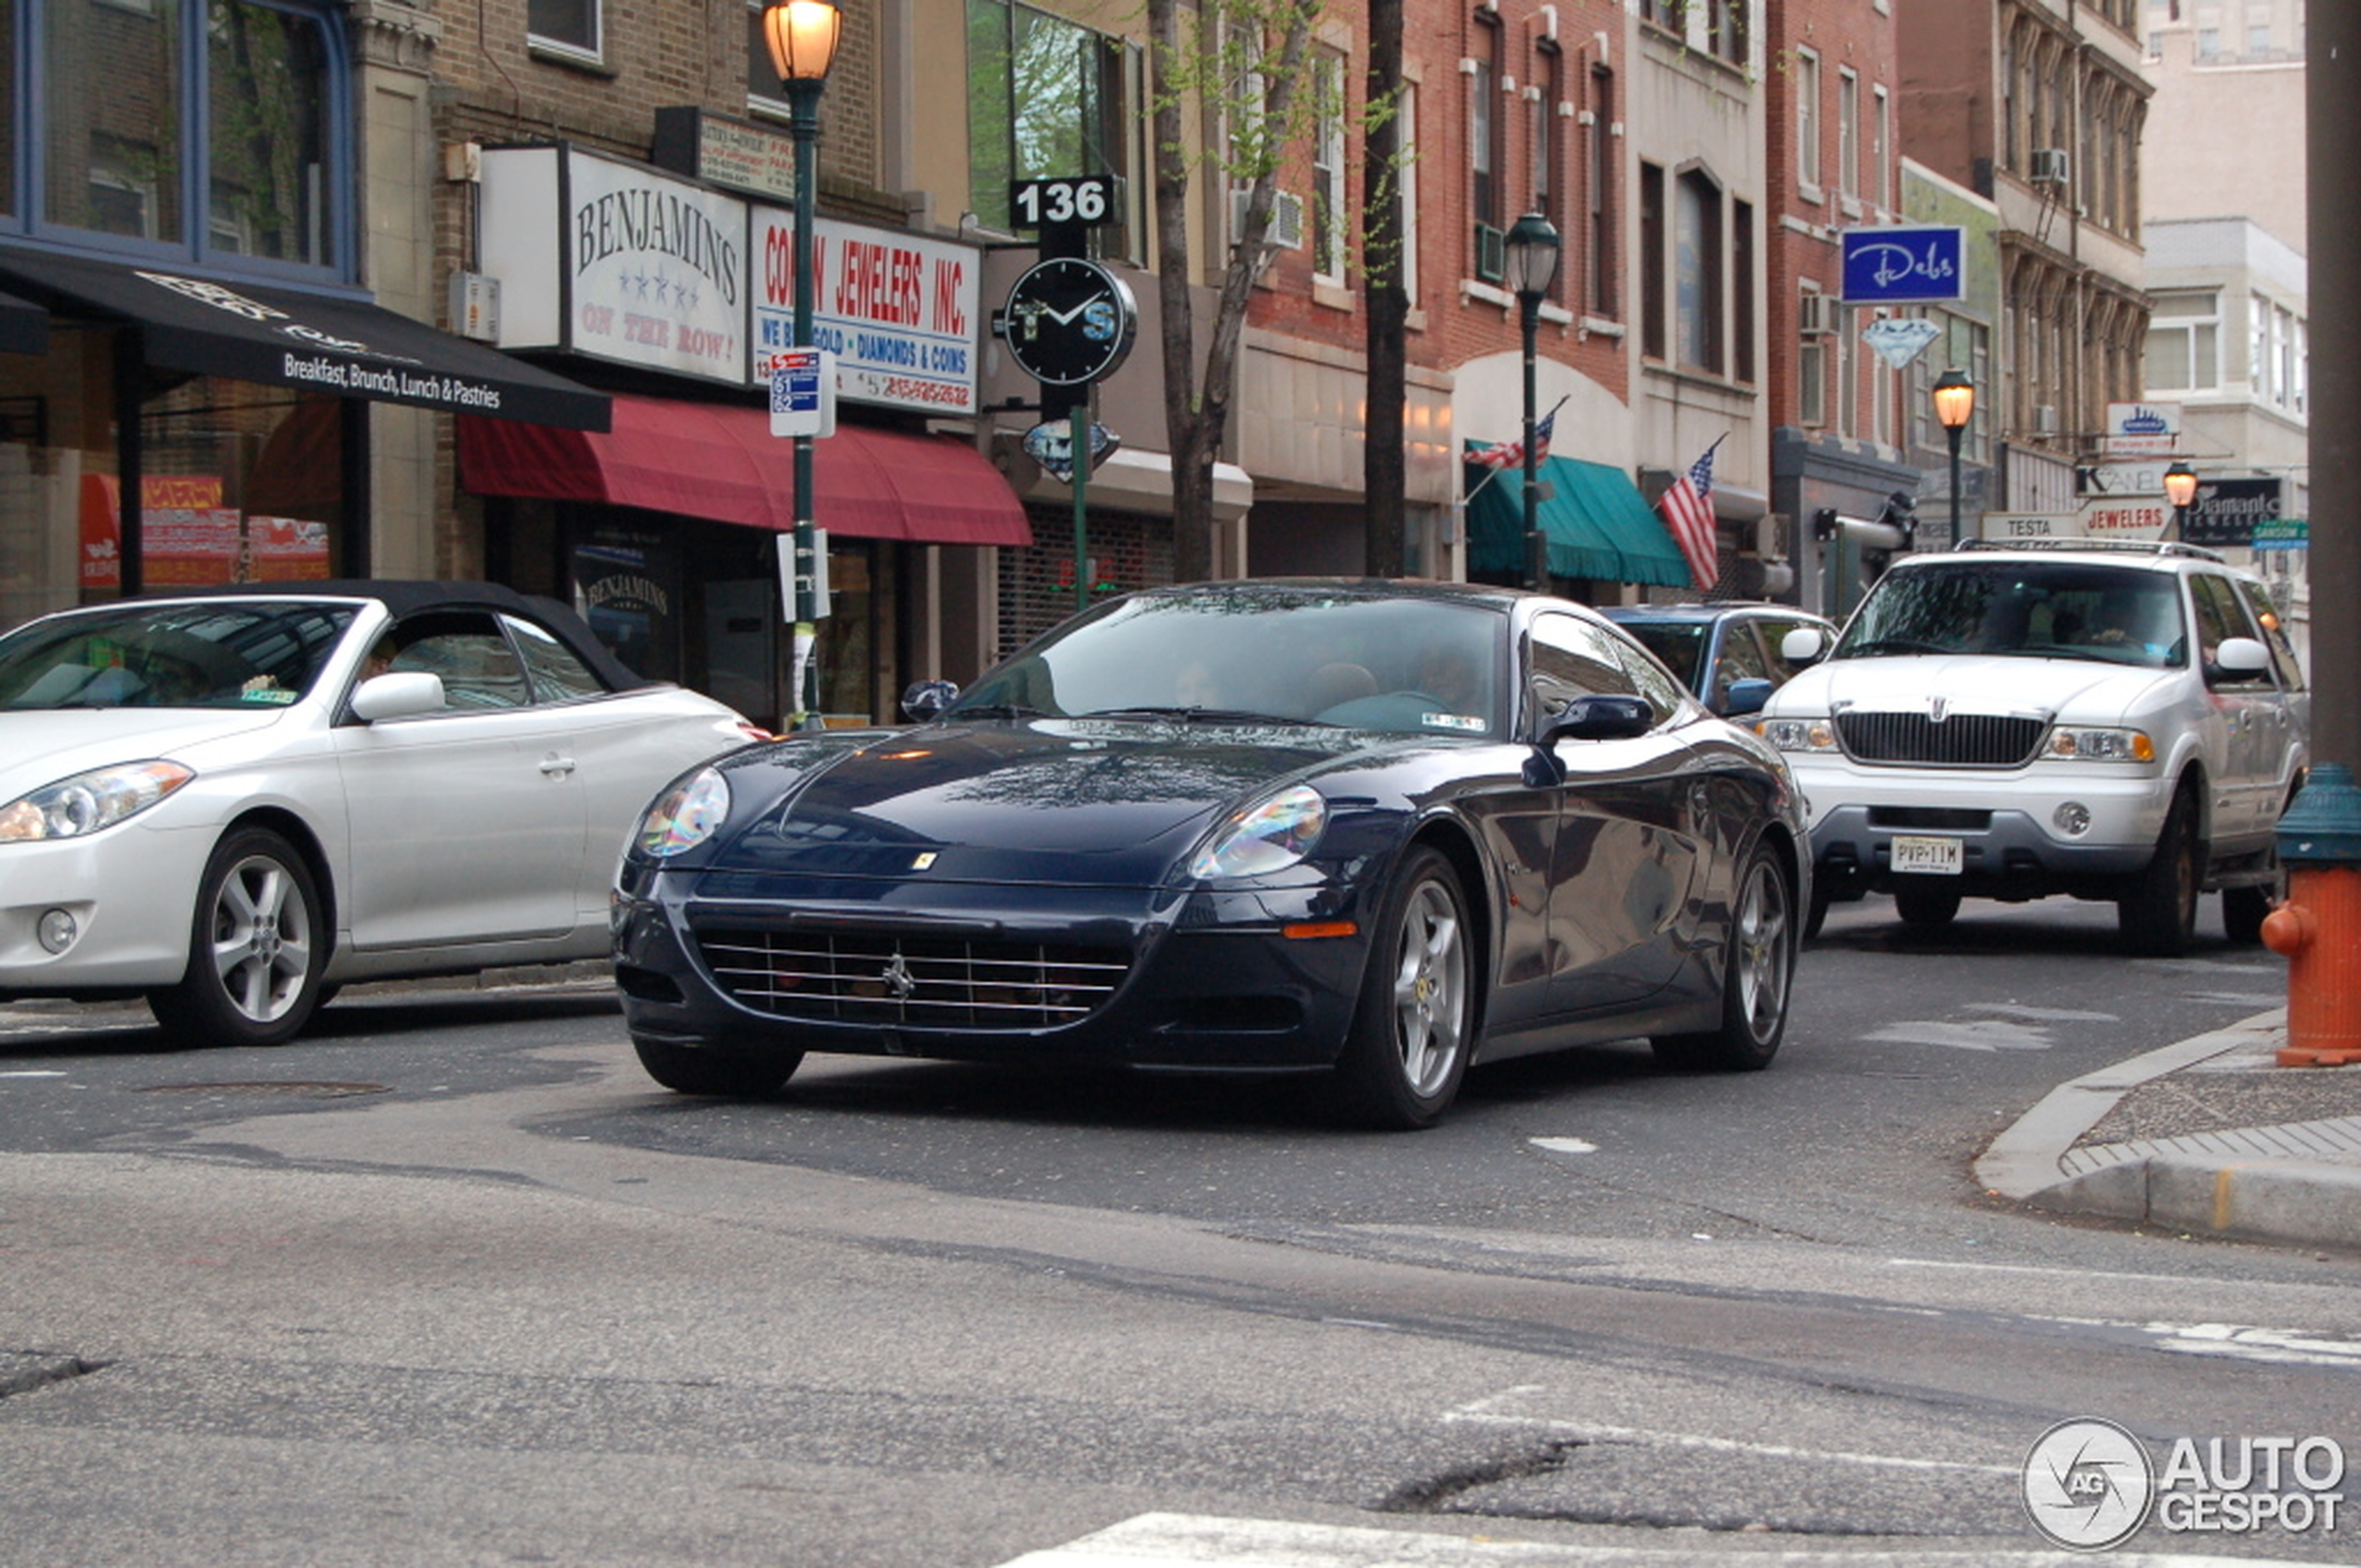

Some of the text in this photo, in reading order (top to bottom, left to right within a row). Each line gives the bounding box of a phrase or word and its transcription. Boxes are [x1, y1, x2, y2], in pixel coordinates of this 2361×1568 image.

[1017, 181, 1105, 222] 136
[577, 189, 736, 306] BENJAMINS
[1849, 242, 1953, 287] Debs
[765, 225, 965, 336] CON JEWELERS INC.
[582, 303, 614, 336] ON
[624, 312, 668, 348] THE
[761, 318, 780, 347] WE
[812, 325, 843, 355] GOLD
[857, 334, 916, 367] DIAMONDS
[920, 345, 929, 370] &
[931, 345, 967, 375] COINS
[284, 352, 500, 409] Breakfast, Brunch, Lunch & Pastries
[773, 395, 793, 412] 62
[2008, 520, 2051, 536] TESTA
[2088, 507, 2163, 529] JEWELERS
[588, 574, 667, 615] BENJAMINS
